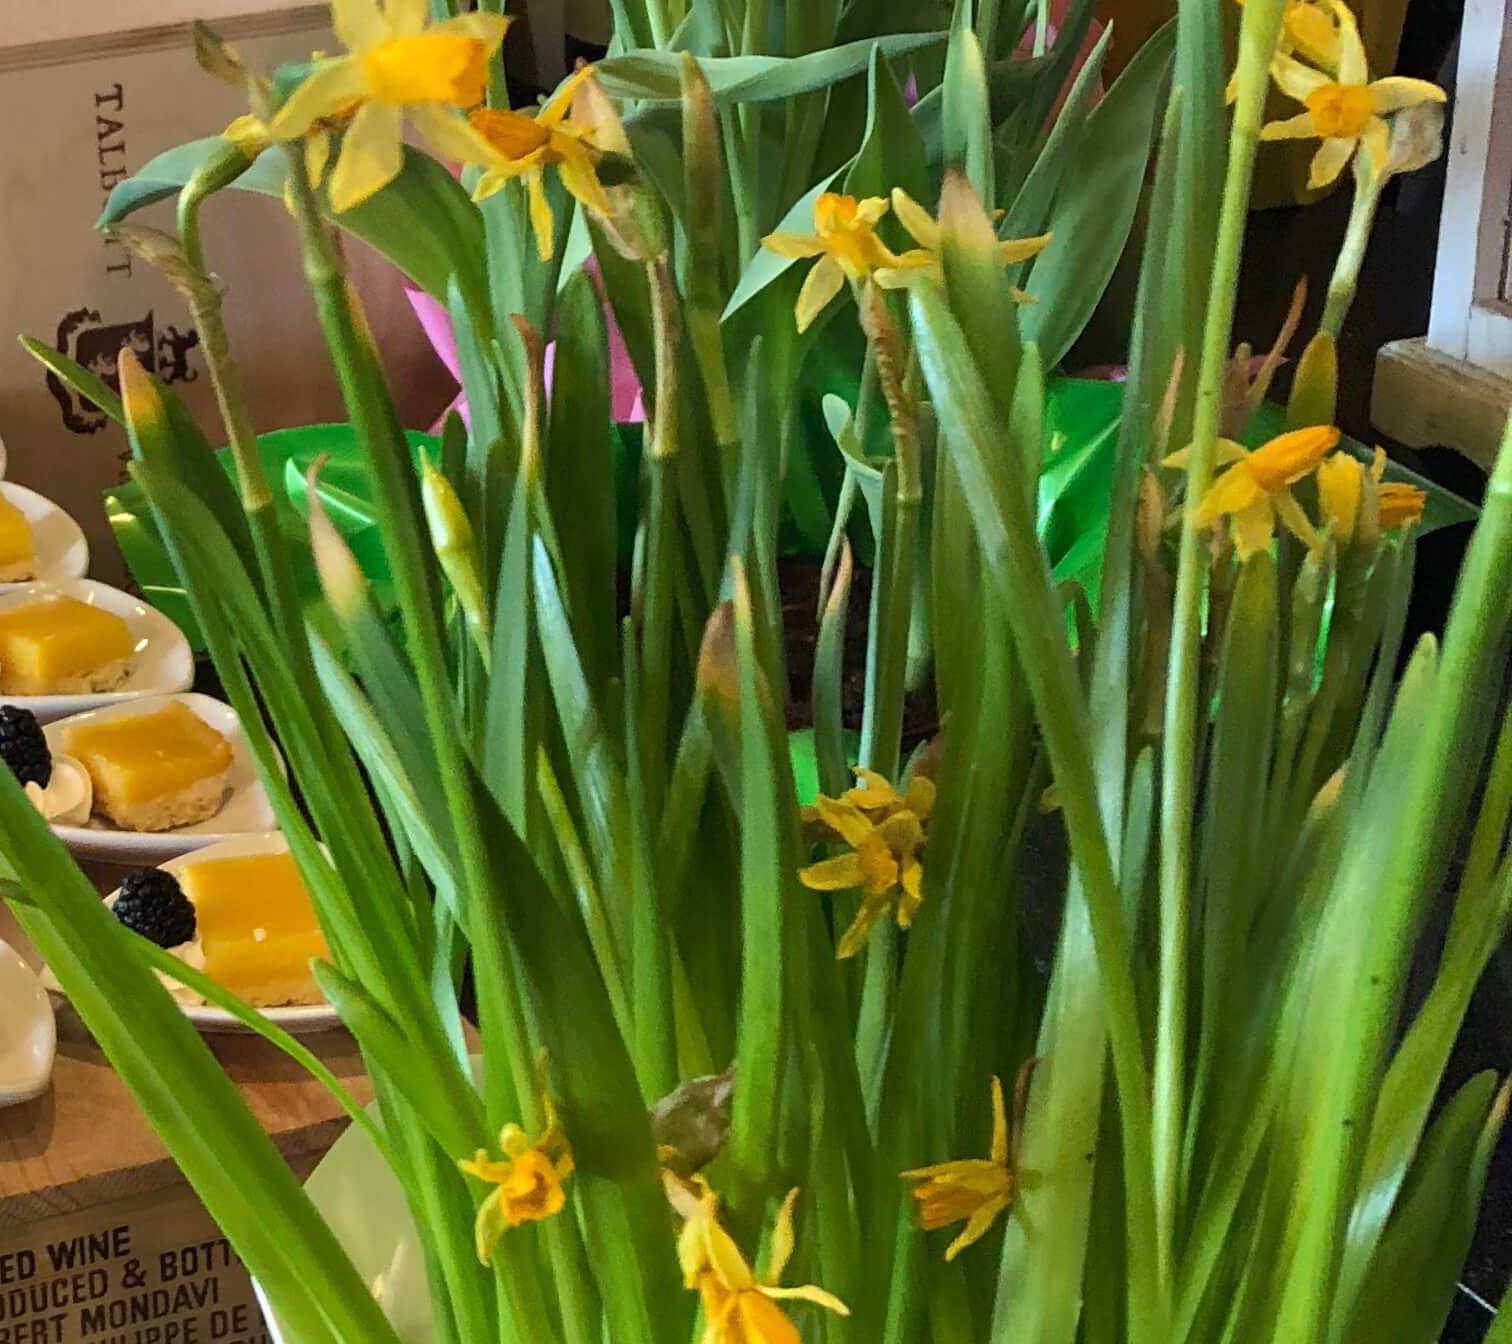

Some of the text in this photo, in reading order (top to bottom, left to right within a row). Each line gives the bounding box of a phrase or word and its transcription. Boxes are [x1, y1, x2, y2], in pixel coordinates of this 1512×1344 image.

[94, 83, 133, 281] TALBT
[46, 1226, 131, 1272] WINE
[122, 1258, 147, 1288] &
[160, 1239, 232, 1281] BOTT
[80, 1277, 218, 1336] MONDAVI
[210, 1304, 248, 1339] DE
